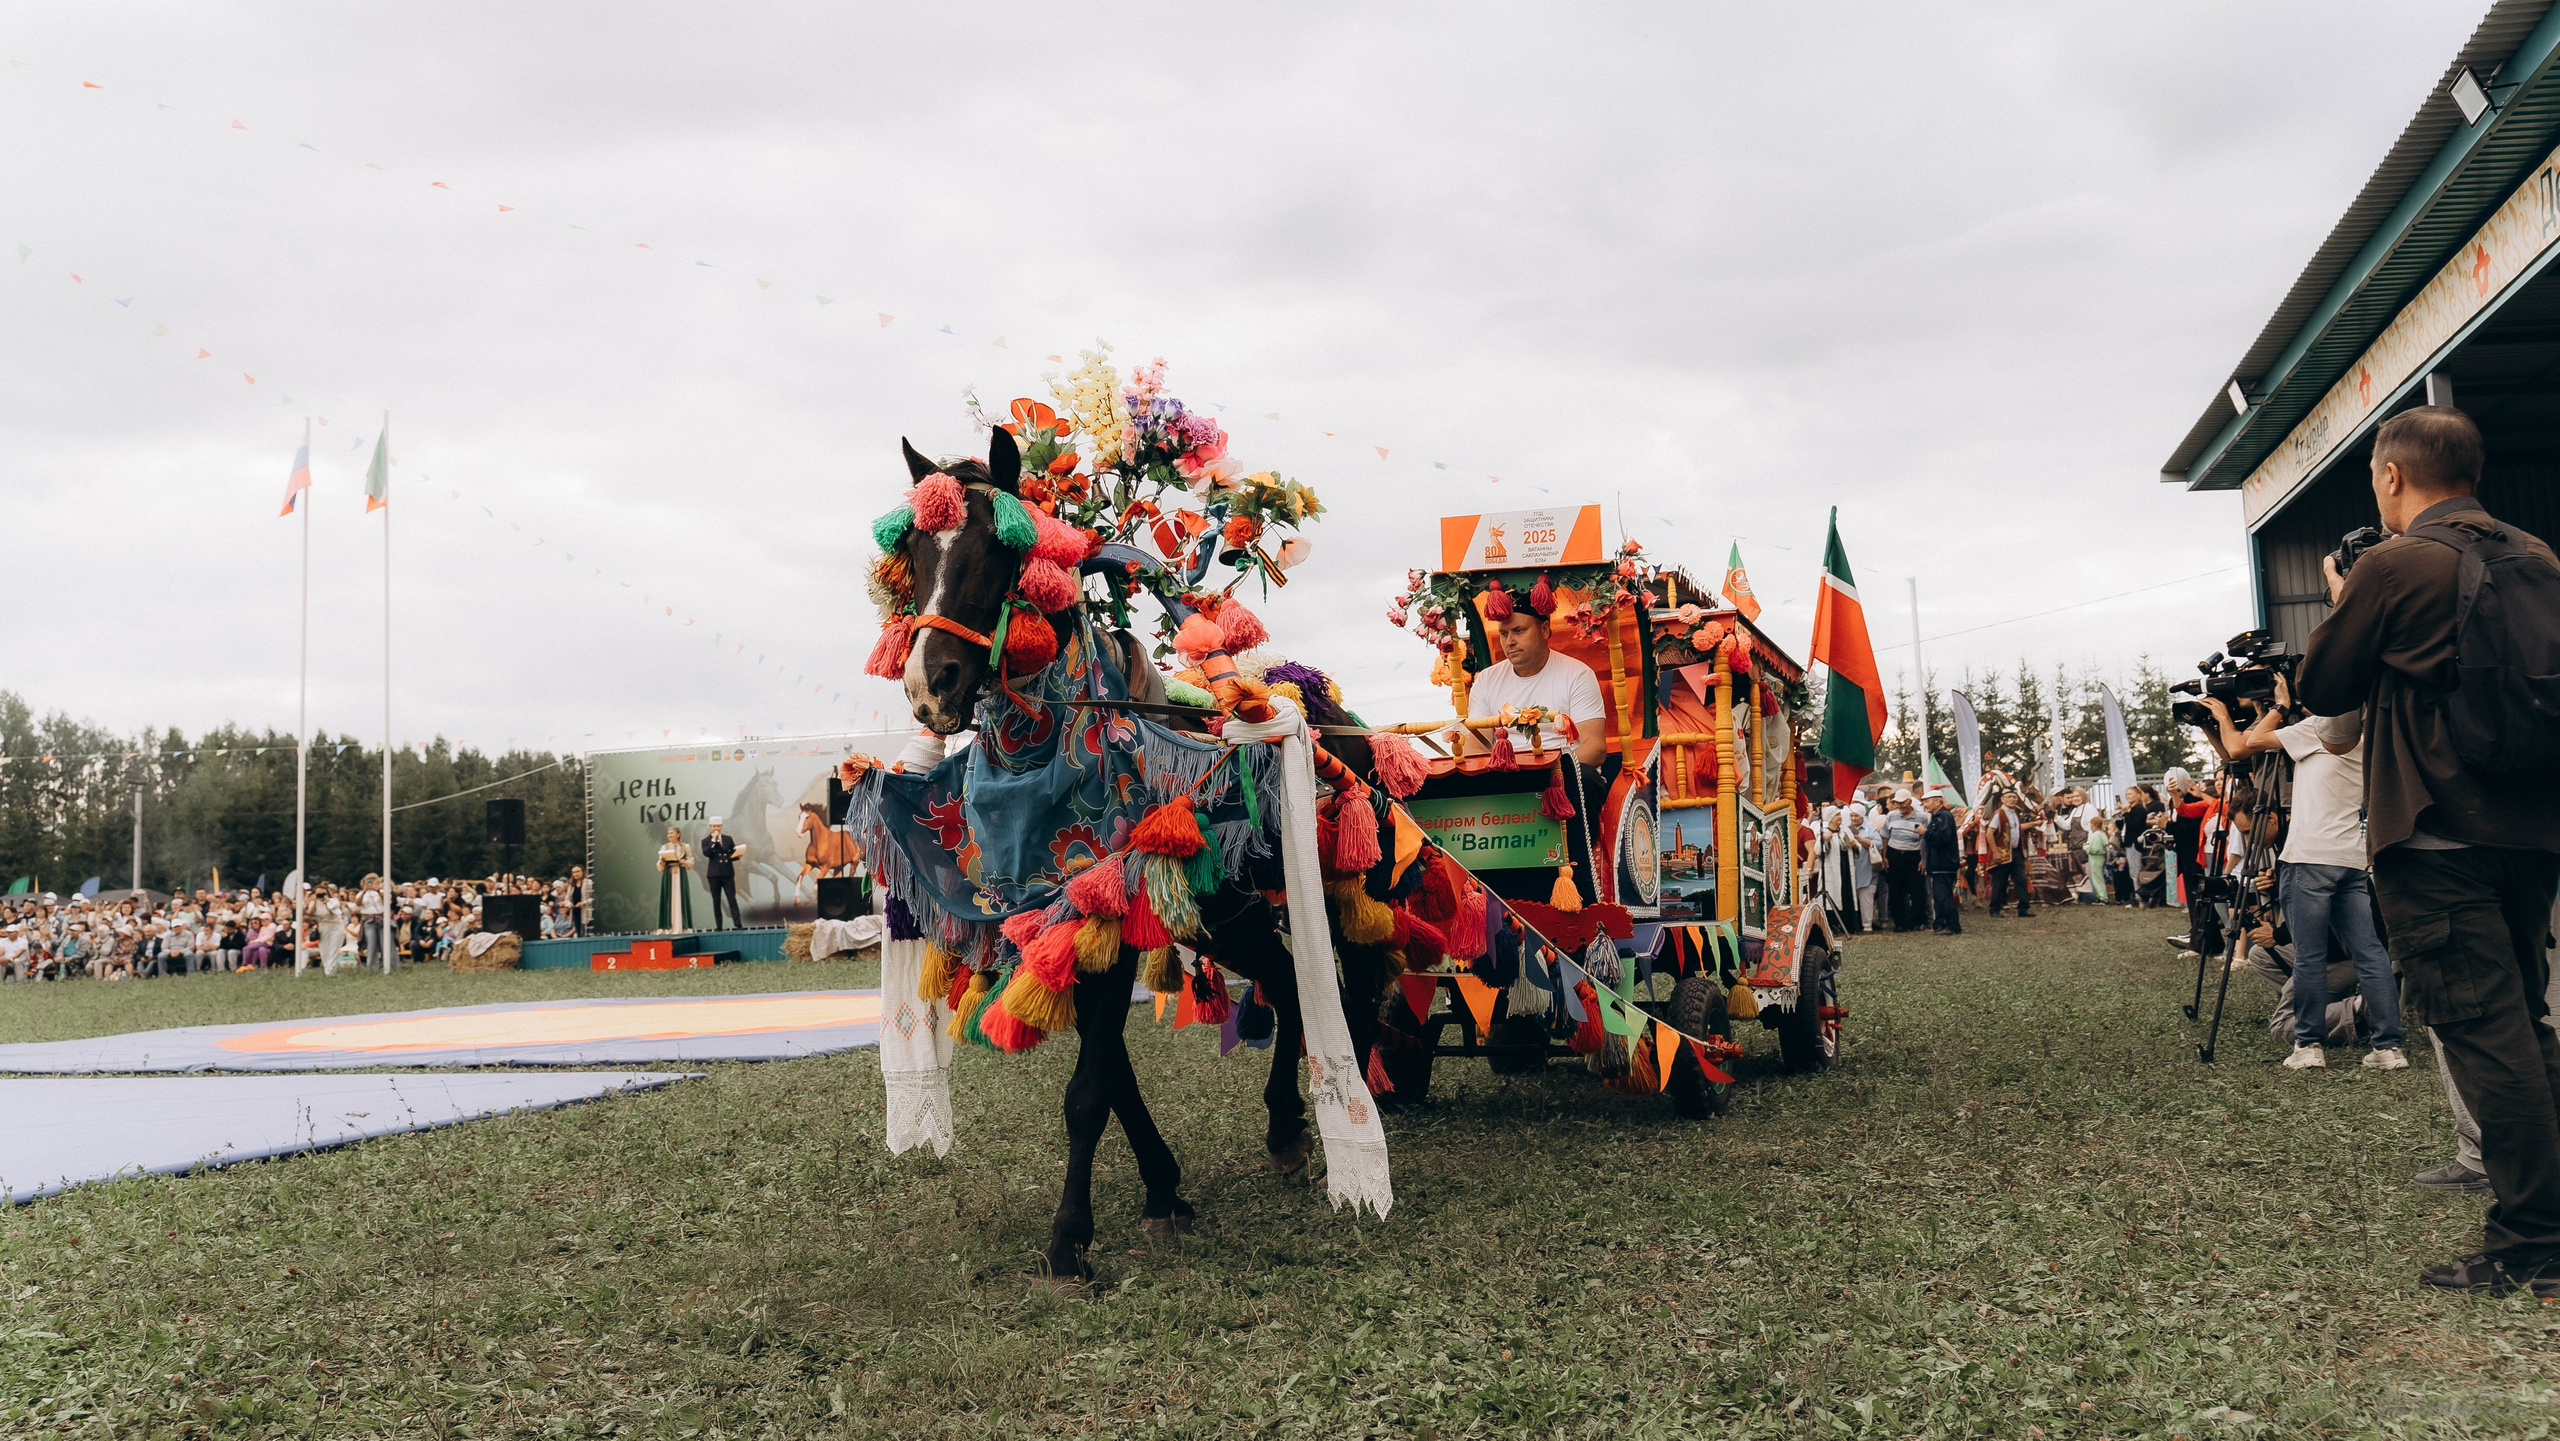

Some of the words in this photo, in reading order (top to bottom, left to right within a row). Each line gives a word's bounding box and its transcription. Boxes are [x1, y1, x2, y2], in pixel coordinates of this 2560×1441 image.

[1523, 529, 1556, 544] 2025
[1415, 815, 1476, 831] Бәйрәм
[1481, 809, 1537, 826] белән!
[649, 947, 656, 960] 1
[607, 957, 617, 970] 2
[689, 957, 698, 970] 3
